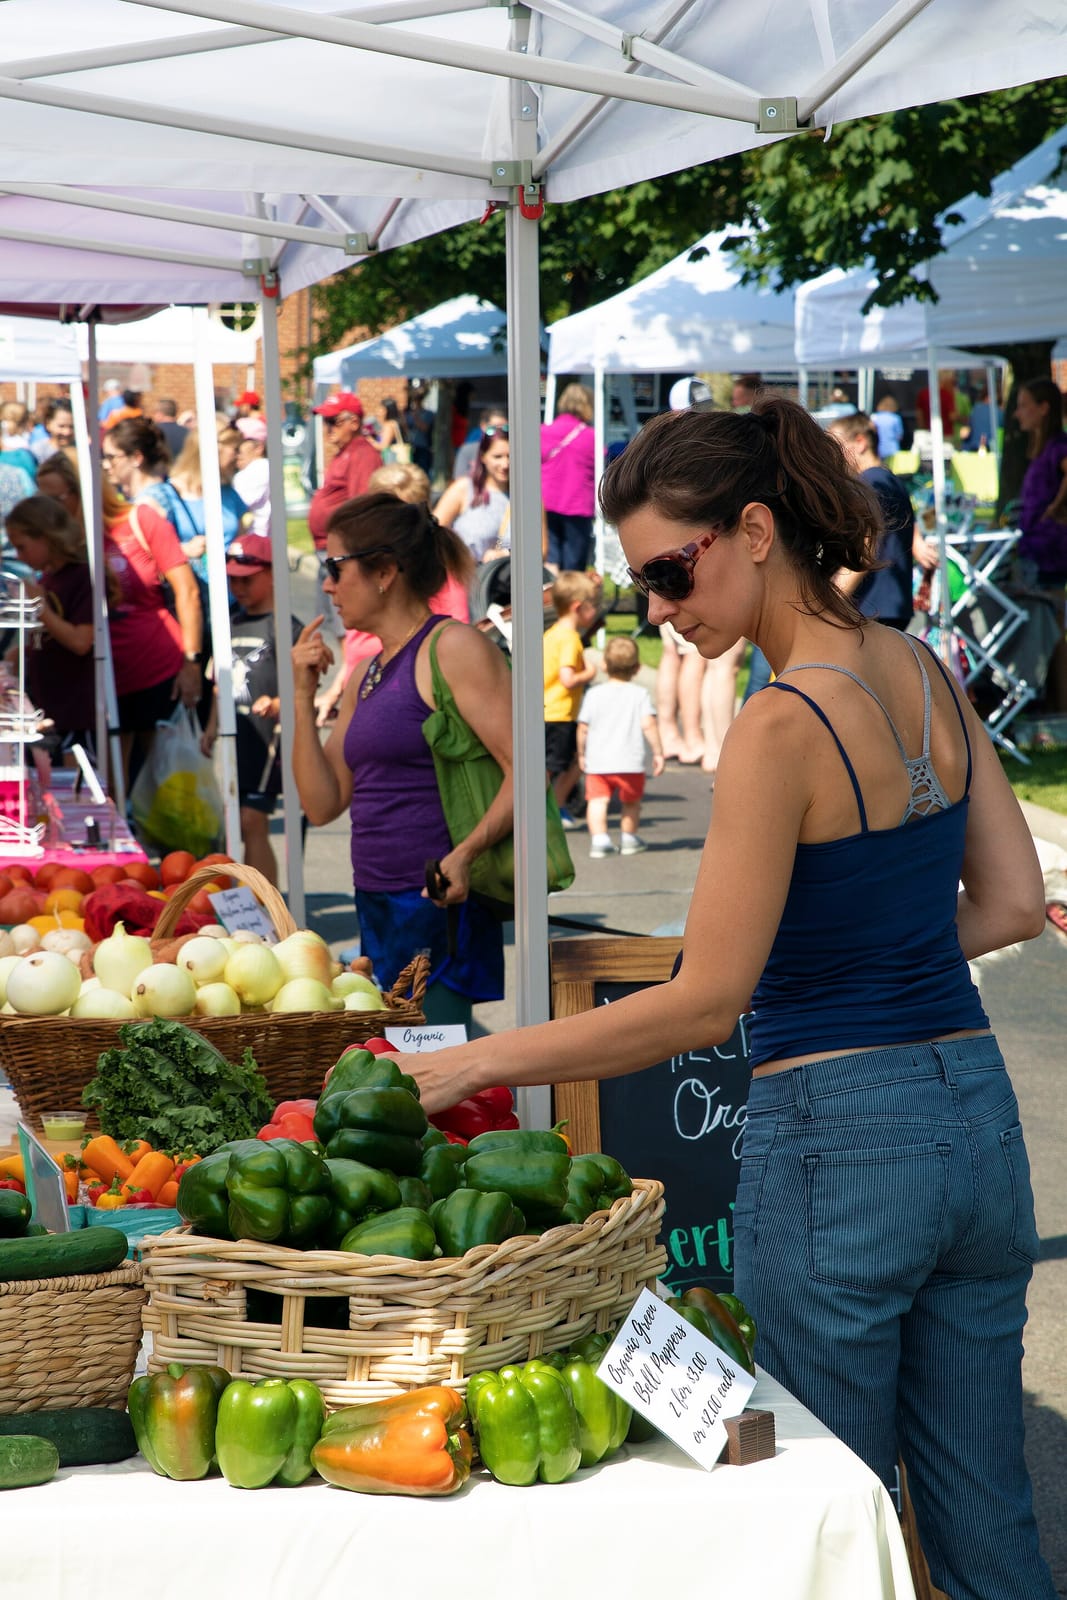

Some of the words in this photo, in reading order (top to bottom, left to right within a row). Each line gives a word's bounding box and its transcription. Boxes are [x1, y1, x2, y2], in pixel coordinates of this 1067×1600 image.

[403, 1028, 446, 1047] Organic
[657, 1204, 734, 1279] ert
[607, 1337, 640, 1385] Organic
[631, 1304, 657, 1345] Green
[633, 1363, 661, 1405] Bell
[649, 1324, 687, 1374] Peppers
[686, 1351, 708, 1384] $3.00
[669, 1401, 682, 1418] 2
[671, 1384, 692, 1410] for
[692, 1428, 707, 1444] or
[701, 1394, 722, 1428] $2.00
[716, 1358, 736, 1398] each
